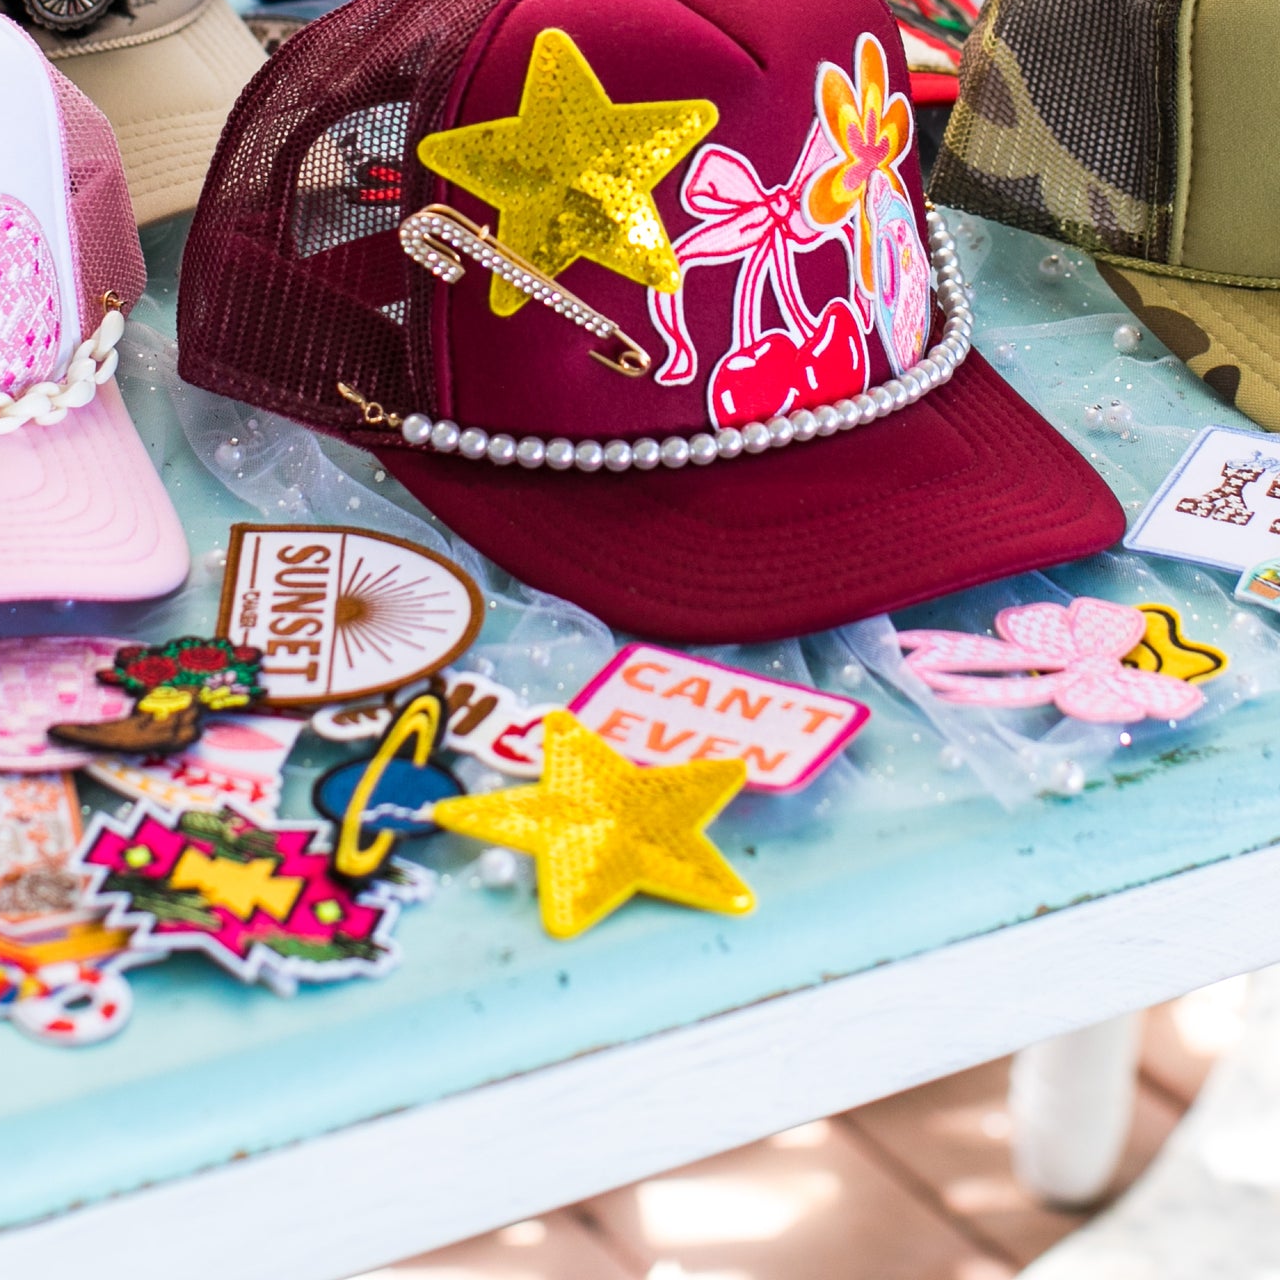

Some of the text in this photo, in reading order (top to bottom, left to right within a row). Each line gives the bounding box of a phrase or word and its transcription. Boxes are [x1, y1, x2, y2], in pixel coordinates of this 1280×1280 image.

[264, 544, 332, 682] SUNSET
[621, 661, 845, 735] CAN'T
[595, 707, 790, 773] EVEN
